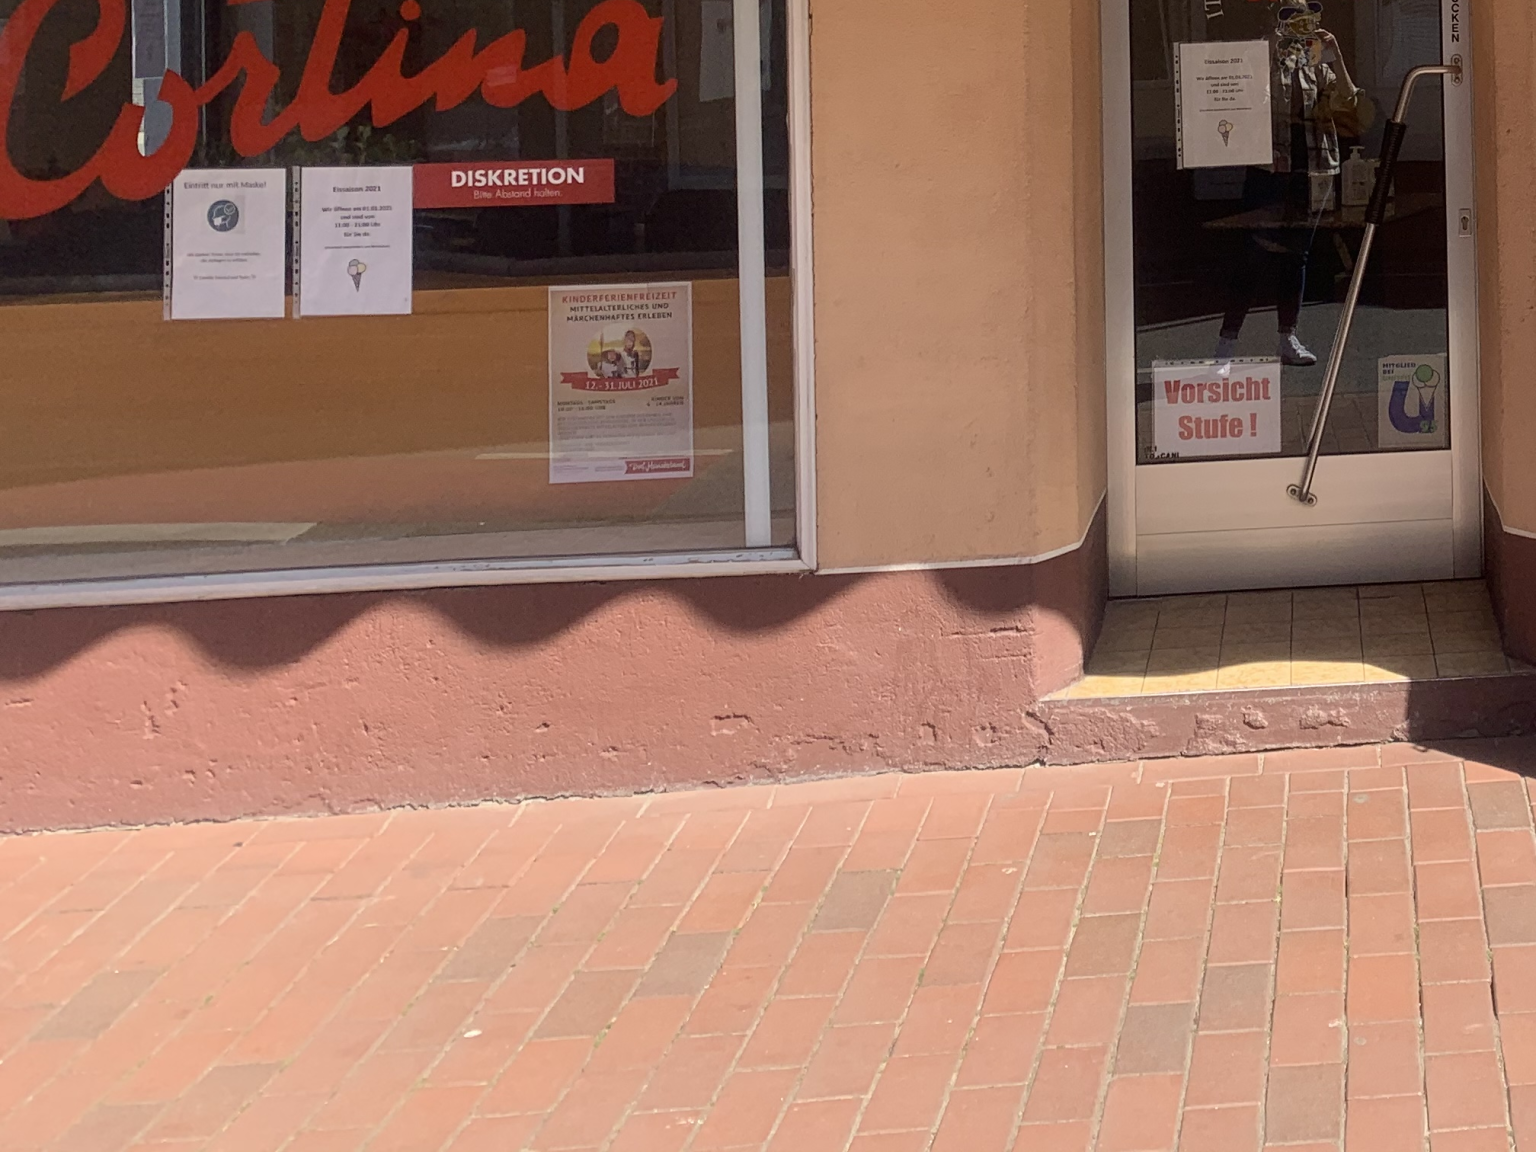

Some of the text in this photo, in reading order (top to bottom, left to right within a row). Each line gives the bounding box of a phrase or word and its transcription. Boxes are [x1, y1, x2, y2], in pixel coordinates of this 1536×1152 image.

[451, 167, 585, 188] DISKRETION
[183, 181, 210, 190] Eintritt
[226, 181, 239, 189] mit
[240, 180, 267, 189] Maske!
[332, 185, 364, 193] Eissaison
[473, 188, 563, 200] Bitte Abstand halten.
[561, 291, 677, 304] KINDERFERIENFREIZEIT
[569, 303, 650, 313] MITTELALTERLICHES
[566, 312, 673, 322] MÄRCHENHAFTES ERLEBEN
[617, 380, 636, 390] JULI
[638, 377, 659, 388] 2021
[1164, 376, 1271, 404] Vorsicht
[1178, 413, 1258, 440] Stufe !
